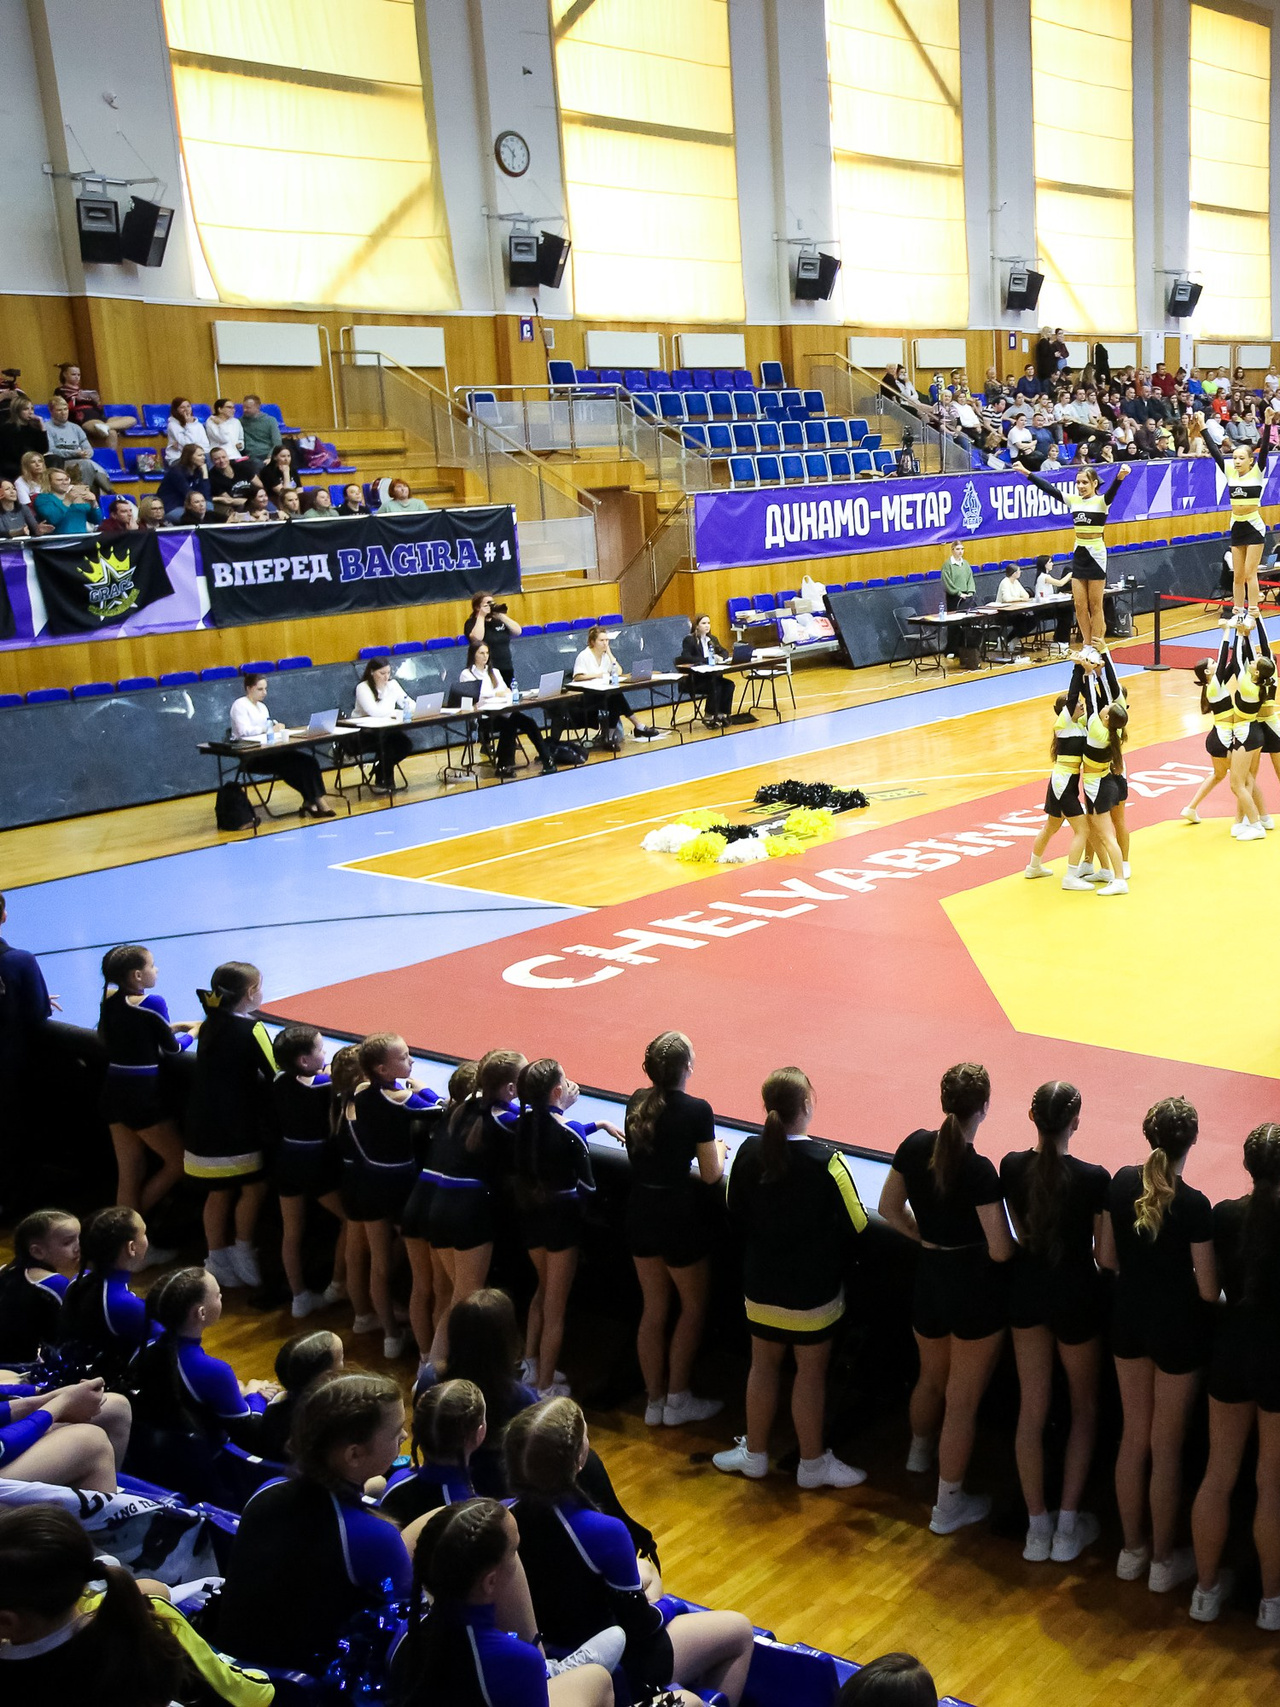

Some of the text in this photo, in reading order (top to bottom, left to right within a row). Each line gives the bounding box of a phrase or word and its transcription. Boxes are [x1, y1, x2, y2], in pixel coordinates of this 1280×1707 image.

[764, 490, 952, 549] ДИНАМО-МЕТАР
[212, 553, 333, 588] ВПЕРЕД
[338, 538, 482, 583] BAGIRA
